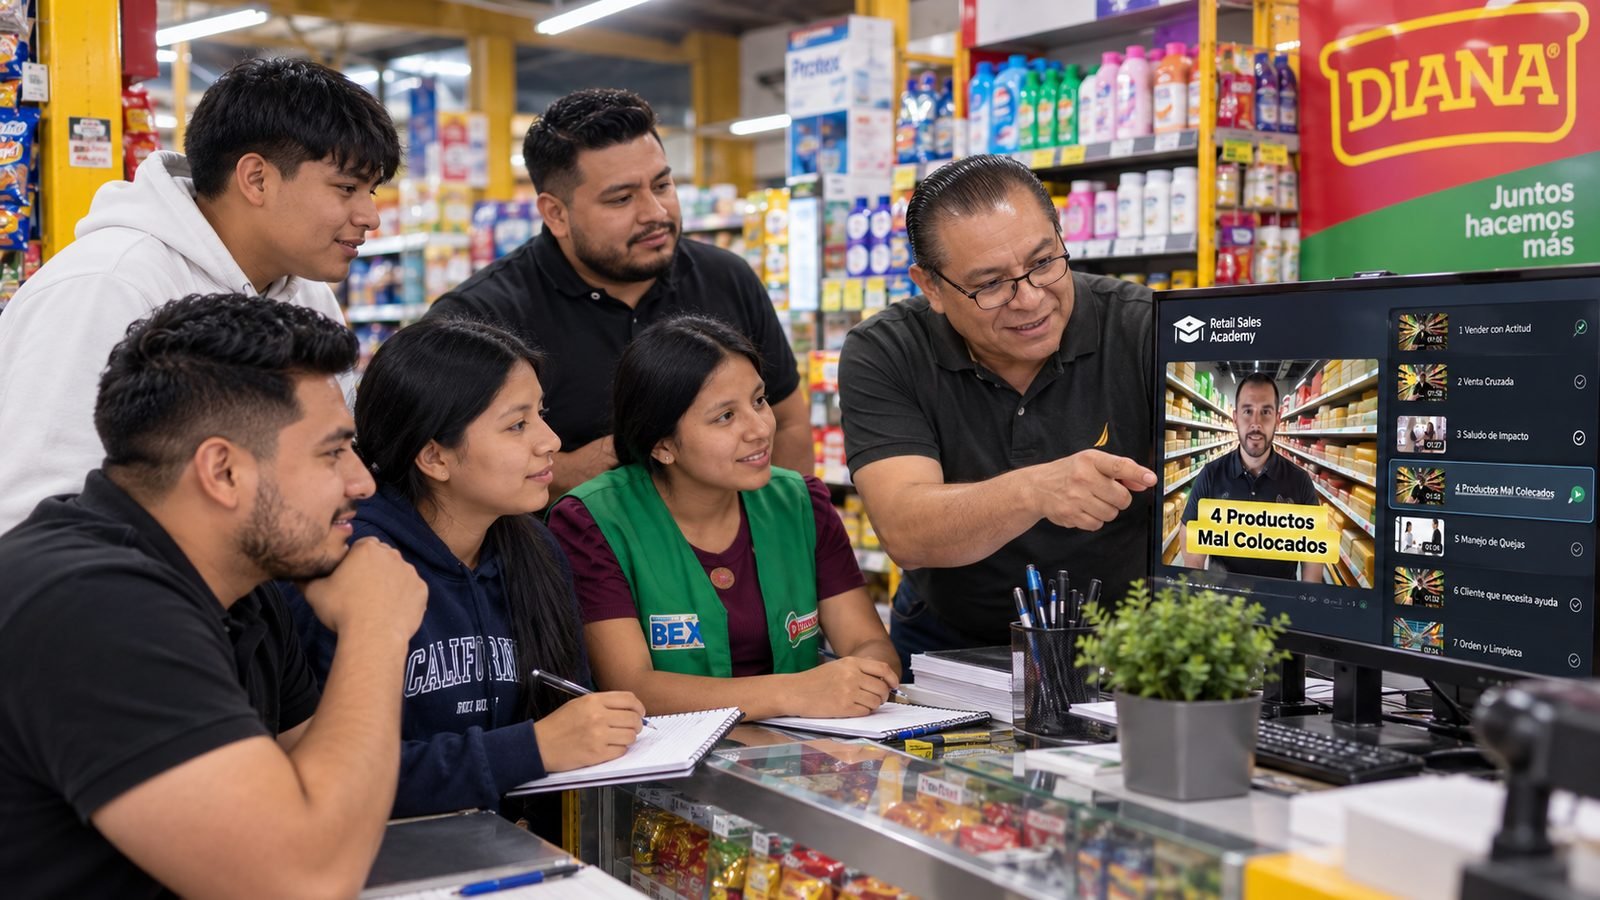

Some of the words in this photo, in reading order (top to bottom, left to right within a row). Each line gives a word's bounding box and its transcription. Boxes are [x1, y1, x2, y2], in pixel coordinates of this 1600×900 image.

[1490, 181, 1575, 210] Juntos
[1465, 209, 1575, 238] hacemos
[1522, 232, 1575, 258] más
[1210, 317, 1235, 329] Retail
[1238, 316, 1262, 328] Sales
[1464, 325, 1489, 334] Vender
[1490, 326, 1504, 334] con
[1505, 323, 1532, 333] Actitud
[1210, 330, 1256, 344] Academy
[1457, 377, 1462, 386] 2
[1463, 377, 1484, 386] Venta
[1485, 376, 1514, 386] Cruzada
[1456, 430, 1461, 439] 3
[1463, 430, 1487, 439] Saludo
[1488, 431, 1497, 440] de
[1499, 431, 1529, 442] Impacto
[1455, 483, 1460, 493] 4
[1462, 483, 1498, 495] Productos
[1210, 508, 1222, 524] 4
[1226, 508, 1315, 530] Productos
[1198, 529, 1229, 548] Mal
[1233, 531, 1328, 555] Colocados
[1461, 535, 1487, 547] Manejo
[1488, 536, 1498, 547] de
[1499, 538, 1526, 550] Quejas
[1453, 586, 1459, 595] 6
[1460, 586, 1486, 598] Cliente
[1486, 591, 1501, 600] que
[1502, 593, 1533, 604] necesita
[1534, 596, 1558, 607] ayuda
[651, 621, 704, 646] BEX
[1453, 638, 1458, 647] 7
[1459, 639, 1482, 650] Orden
[1483, 644, 1489, 654] y
[1490, 644, 1523, 658] Limpieza
